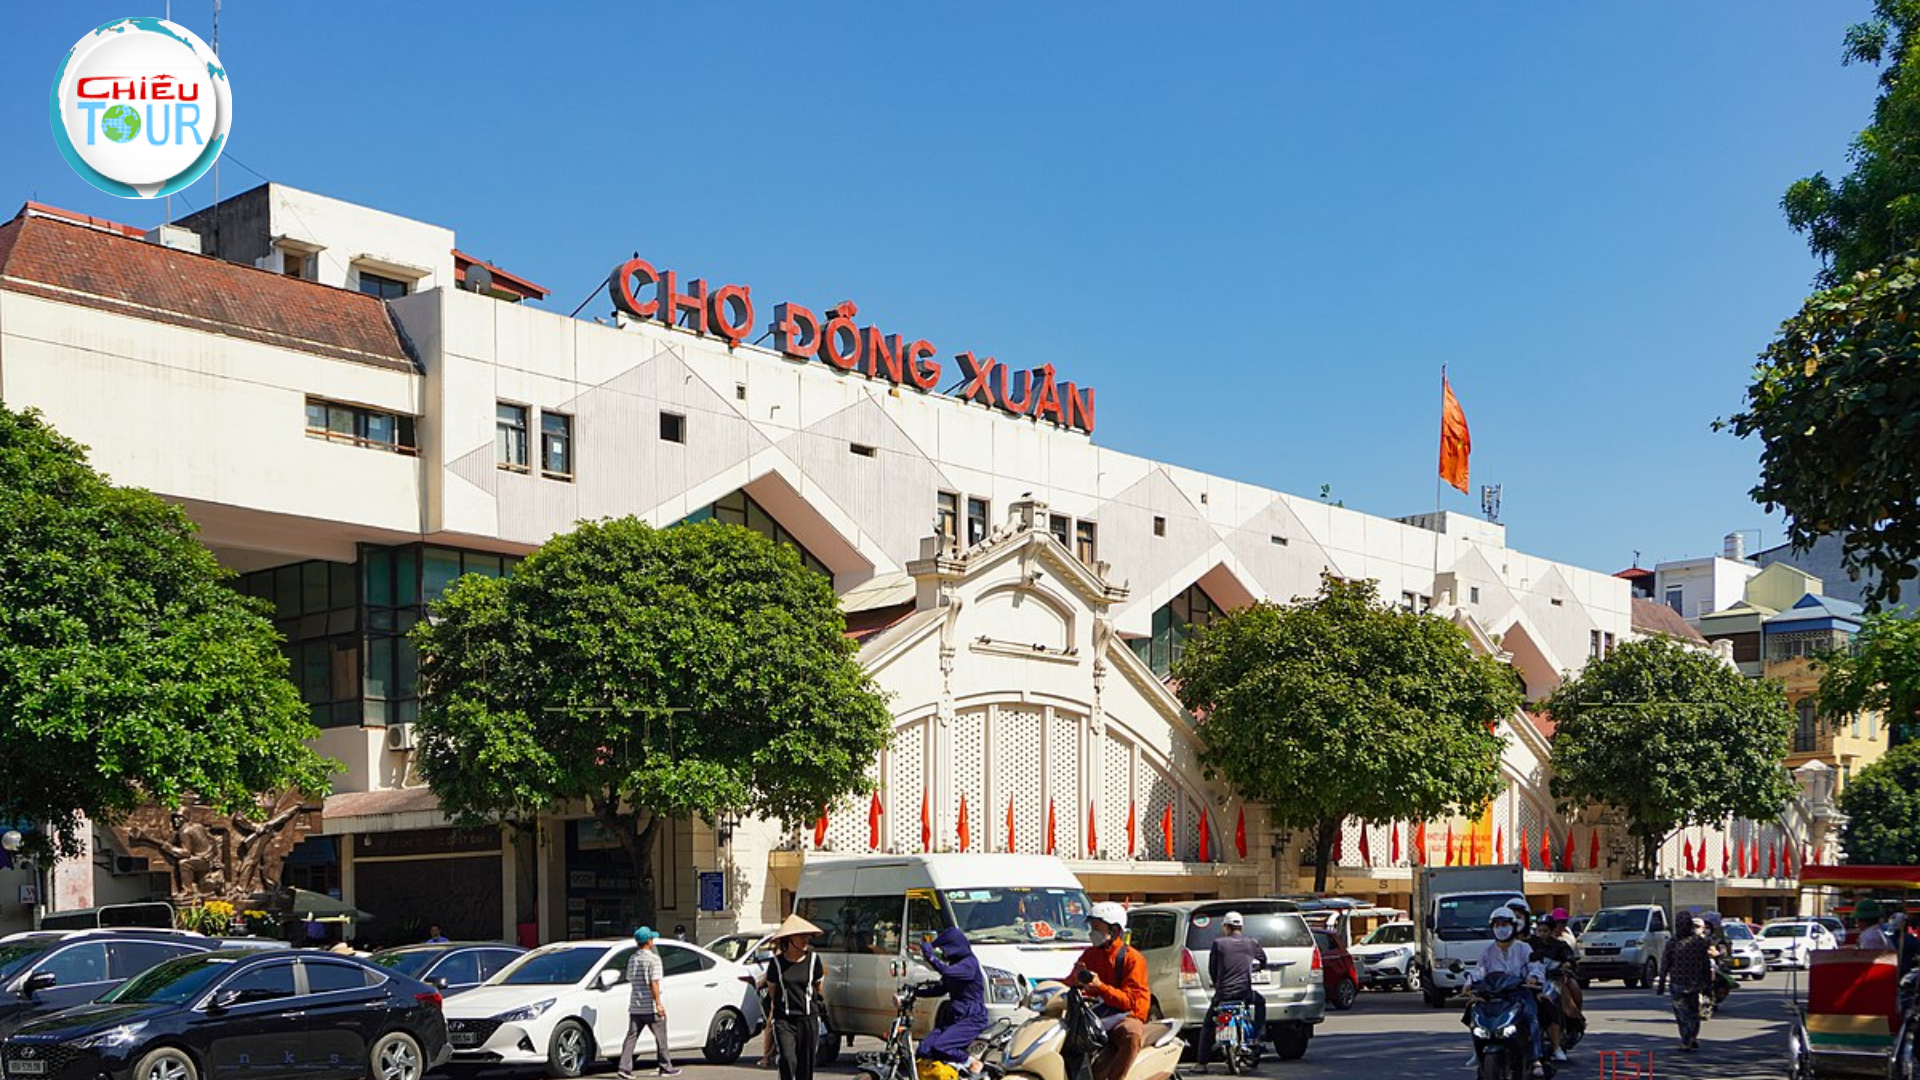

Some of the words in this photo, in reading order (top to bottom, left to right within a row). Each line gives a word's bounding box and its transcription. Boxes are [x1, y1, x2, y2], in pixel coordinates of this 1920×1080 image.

[609, 259, 754, 348] CHỢ
[768, 300, 941, 389] ĐỒNG
[955, 351, 1096, 432] XUÂN
